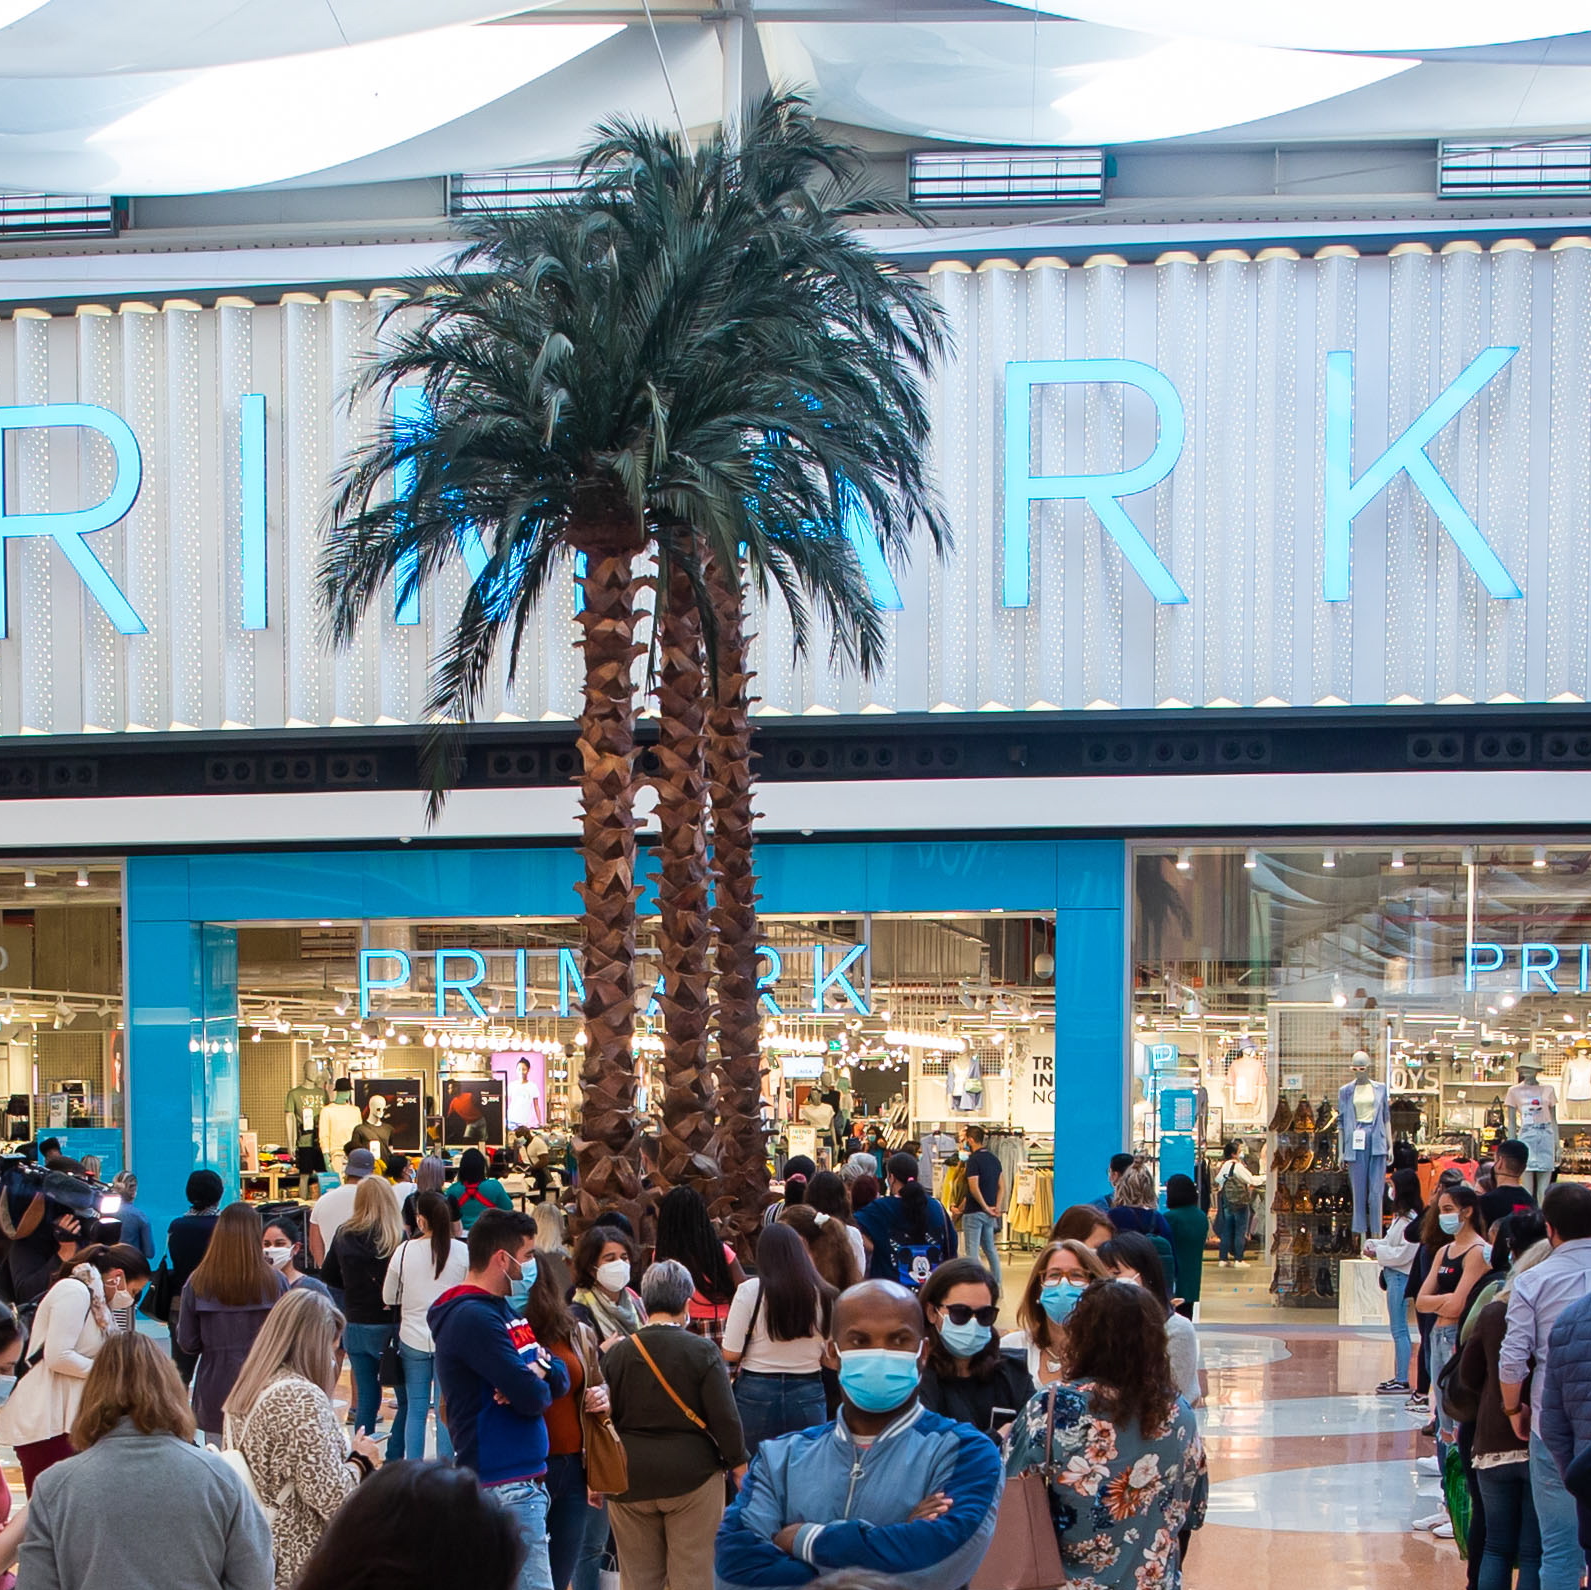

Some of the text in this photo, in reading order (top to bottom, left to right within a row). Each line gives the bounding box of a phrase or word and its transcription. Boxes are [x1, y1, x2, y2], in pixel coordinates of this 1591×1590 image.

[359, 944, 872, 1020] PRIRK
[1033, 1056, 1054, 1071] TR
[1033, 1073, 1054, 1087] IN
[1391, 1068, 1440, 1090] OYS
